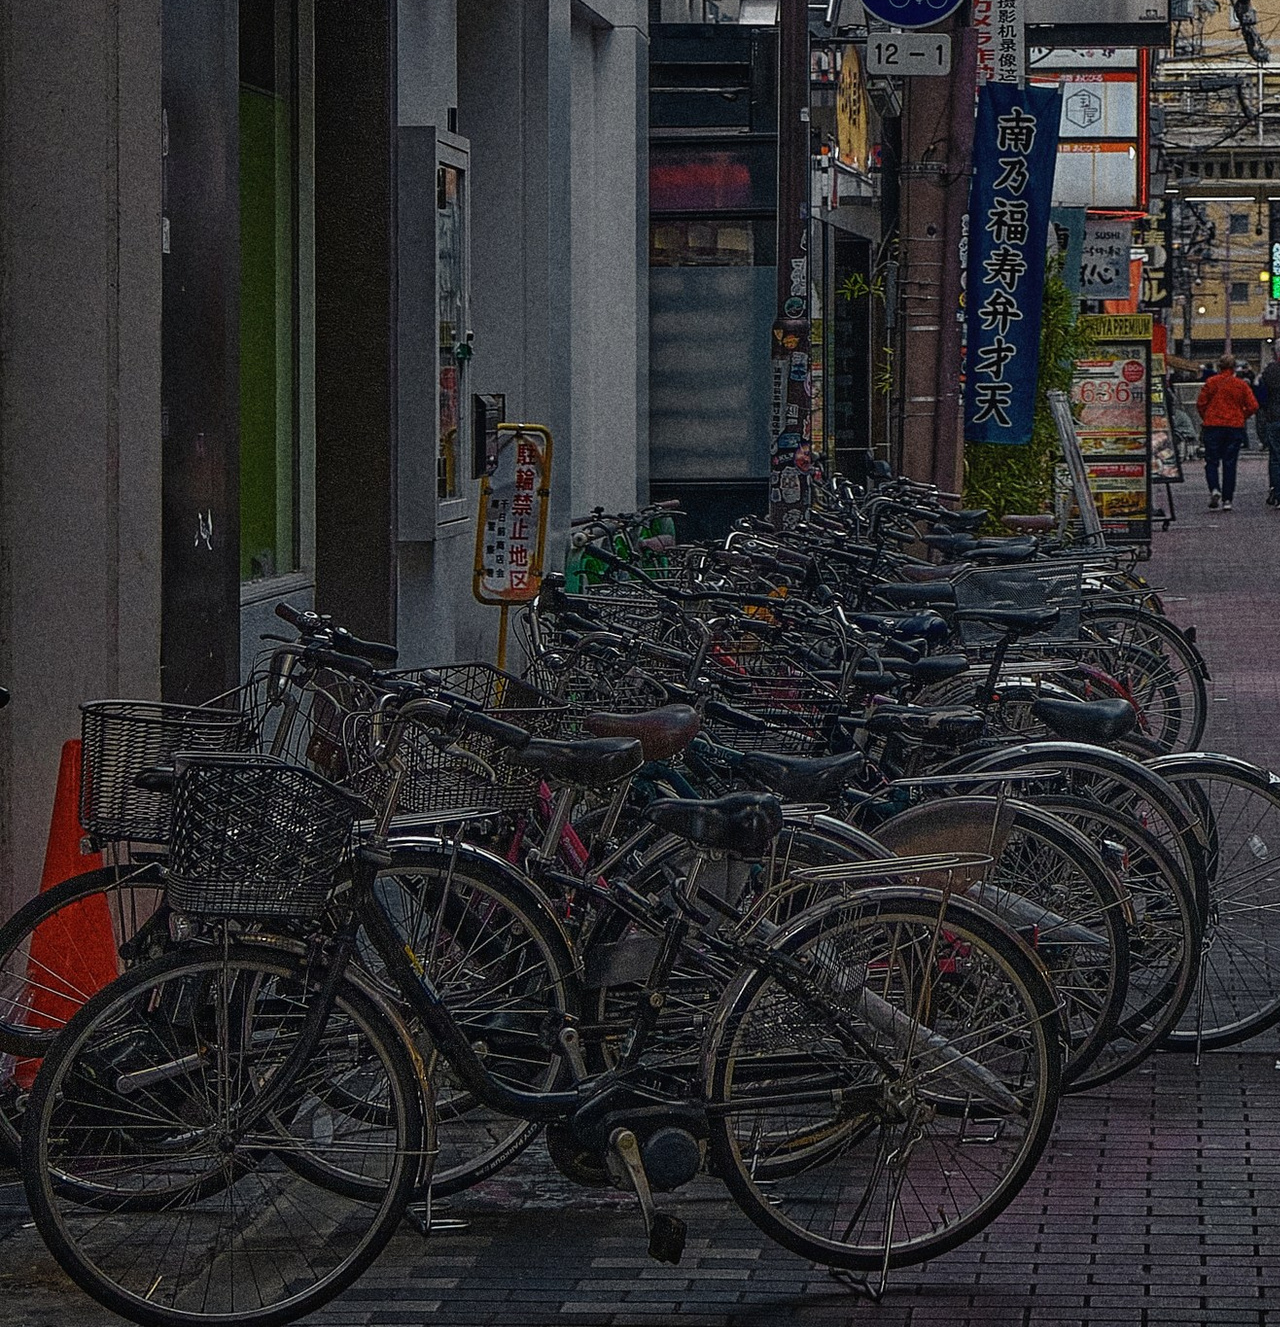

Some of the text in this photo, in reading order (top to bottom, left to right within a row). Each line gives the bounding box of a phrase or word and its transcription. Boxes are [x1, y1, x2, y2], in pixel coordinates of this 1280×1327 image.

[974, 107, 1036, 427] 南乃福寿弁才天
[1095, 231, 1120, 240] SUSHI
[509, 443, 536, 591] 駐輪禁止地区
